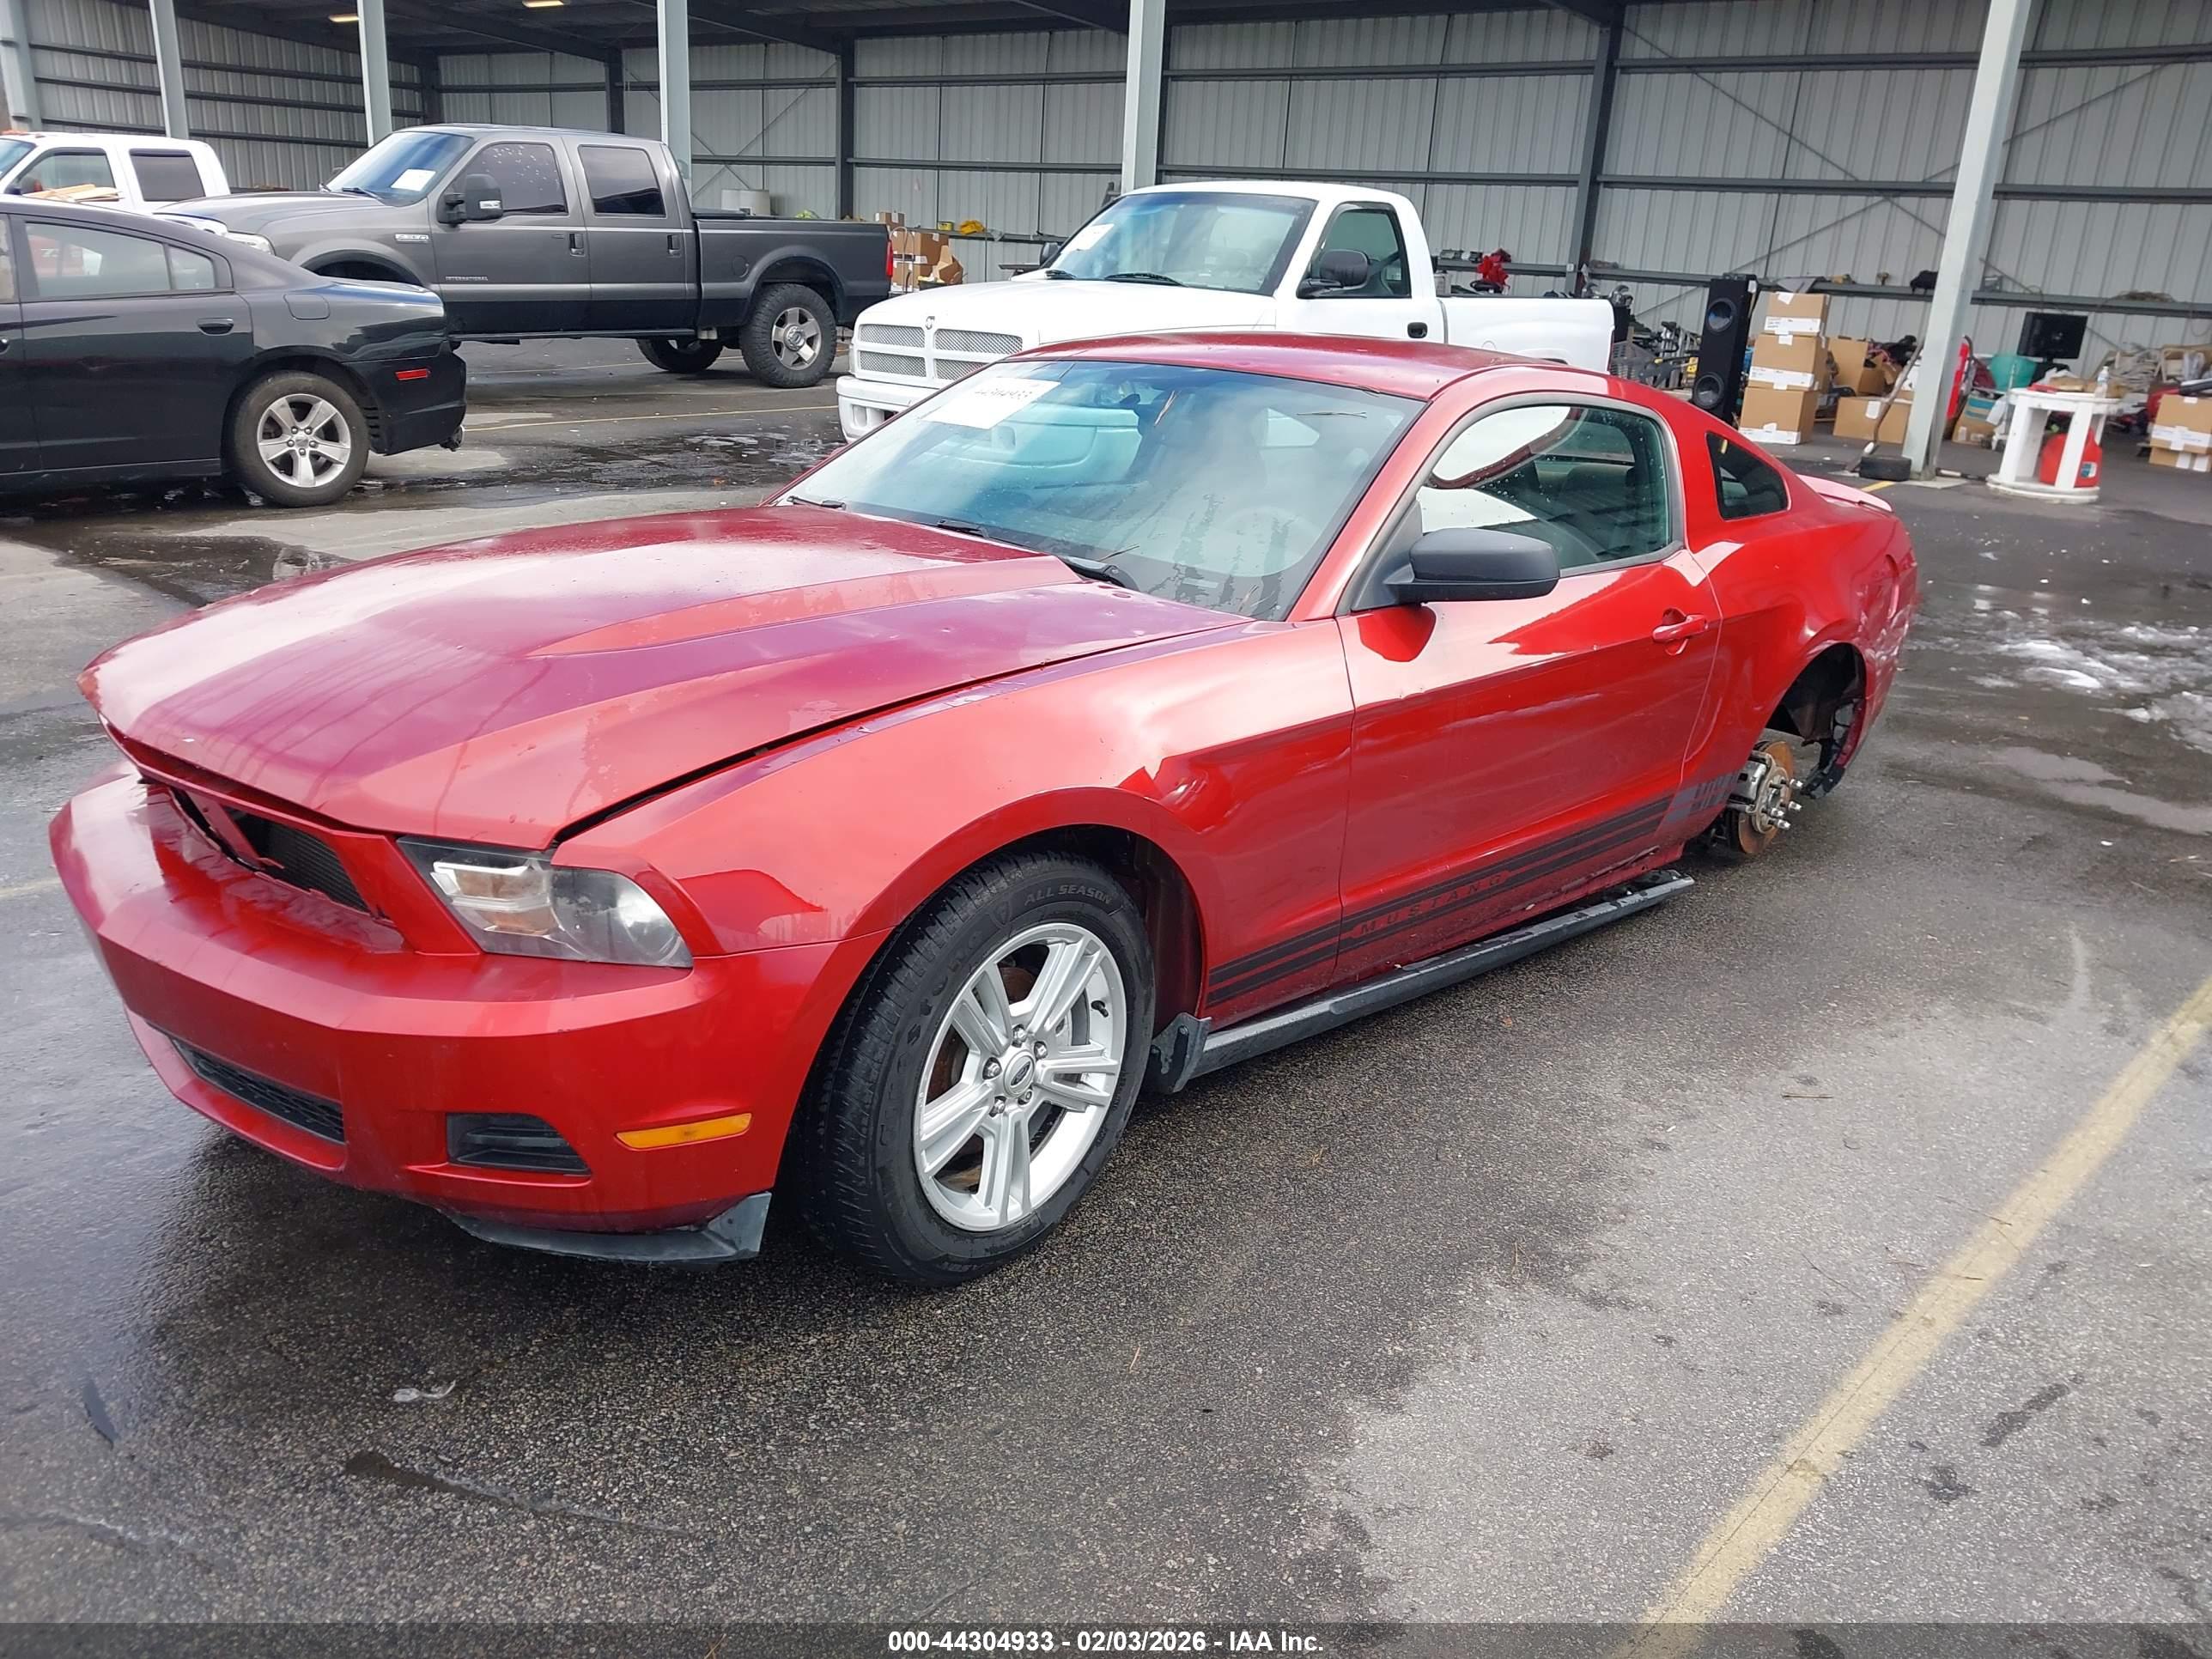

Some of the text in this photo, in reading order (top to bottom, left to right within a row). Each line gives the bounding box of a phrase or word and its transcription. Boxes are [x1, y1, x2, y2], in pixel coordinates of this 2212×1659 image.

[1024, 884, 1113, 906] ALL SEASON
[1359, 873, 1502, 935] MUSTANG
